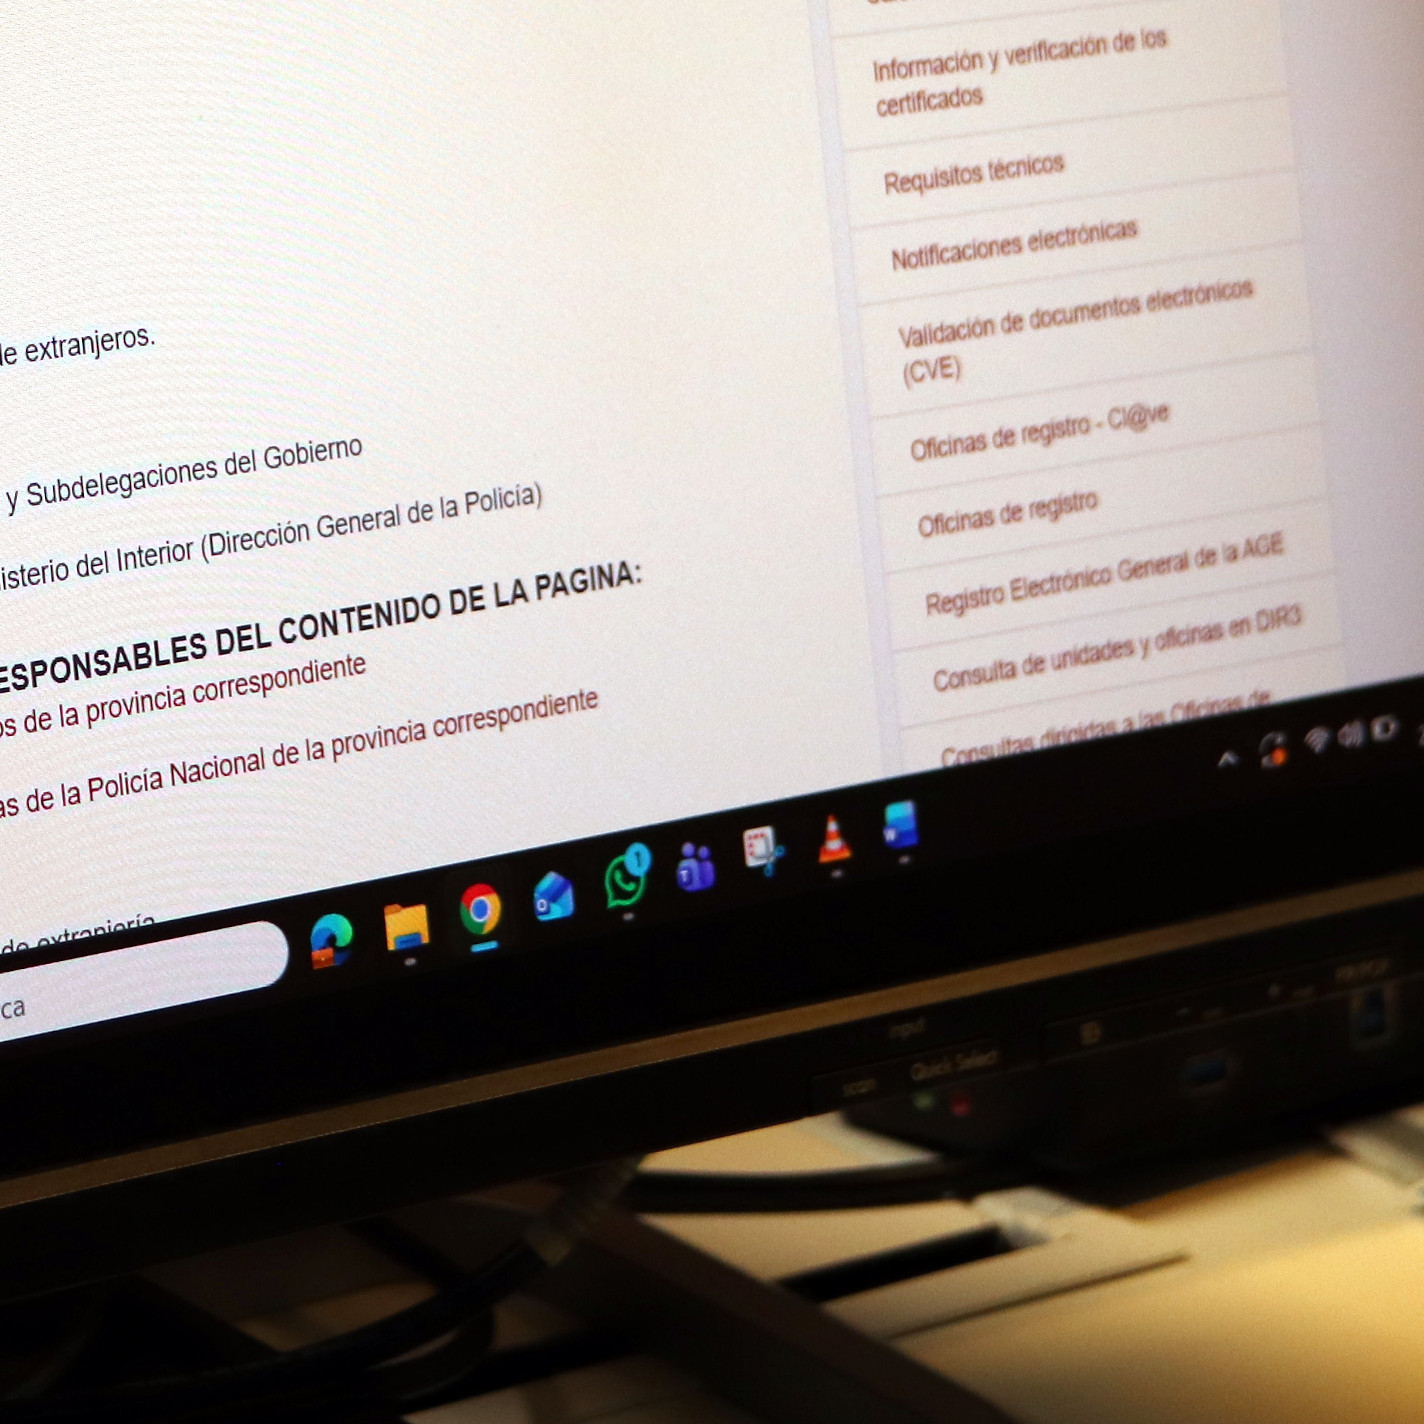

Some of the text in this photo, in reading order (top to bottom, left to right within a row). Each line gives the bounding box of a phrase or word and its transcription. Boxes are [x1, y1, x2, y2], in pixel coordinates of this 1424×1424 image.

[872, 28, 1169, 83] Información y verificación de los
[876, 86, 984, 118] certificados
[883, 153, 1066, 196] Requisitos técnicos
[891, 219, 1139, 271] Notificaciones electrónicas
[24, 327, 156, 363] extranjeros.
[5, 491, 19, 517] y
[27, 460, 218, 507] Subdelegaciones
[224, 449, 257, 476] del
[263, 438, 363, 470] Gobierno
[76, 550, 110, 578] del
[117, 541, 194, 571] Interior
[201, 522, 310, 564] (Dirección
[316, 504, 402, 539] General
[407, 501, 434, 525] de
[439, 497, 459, 519] la
[464, 482, 543, 515] Policía)
[215, 622, 272, 657] DEL
[278, 592, 442, 645] CONTENIDO
[449, 584, 486, 616] DE
[493, 578, 530, 608] LA
[535, 560, 642, 600] PAGINA:
[23, 708, 53, 734] de
[58, 704, 79, 728] la
[86, 687, 187, 729] provincia
[192, 654, 367, 704] correspondiente
[25, 788, 54, 813] de
[60, 782, 81, 807] la
[87, 767, 164, 802] Policía
[169, 747, 266, 787] Nacional
[271, 742, 300, 767] de
[305, 738, 326, 761] la
[331, 722, 427, 764] provincia
[433, 690, 599, 738] correspondiente
